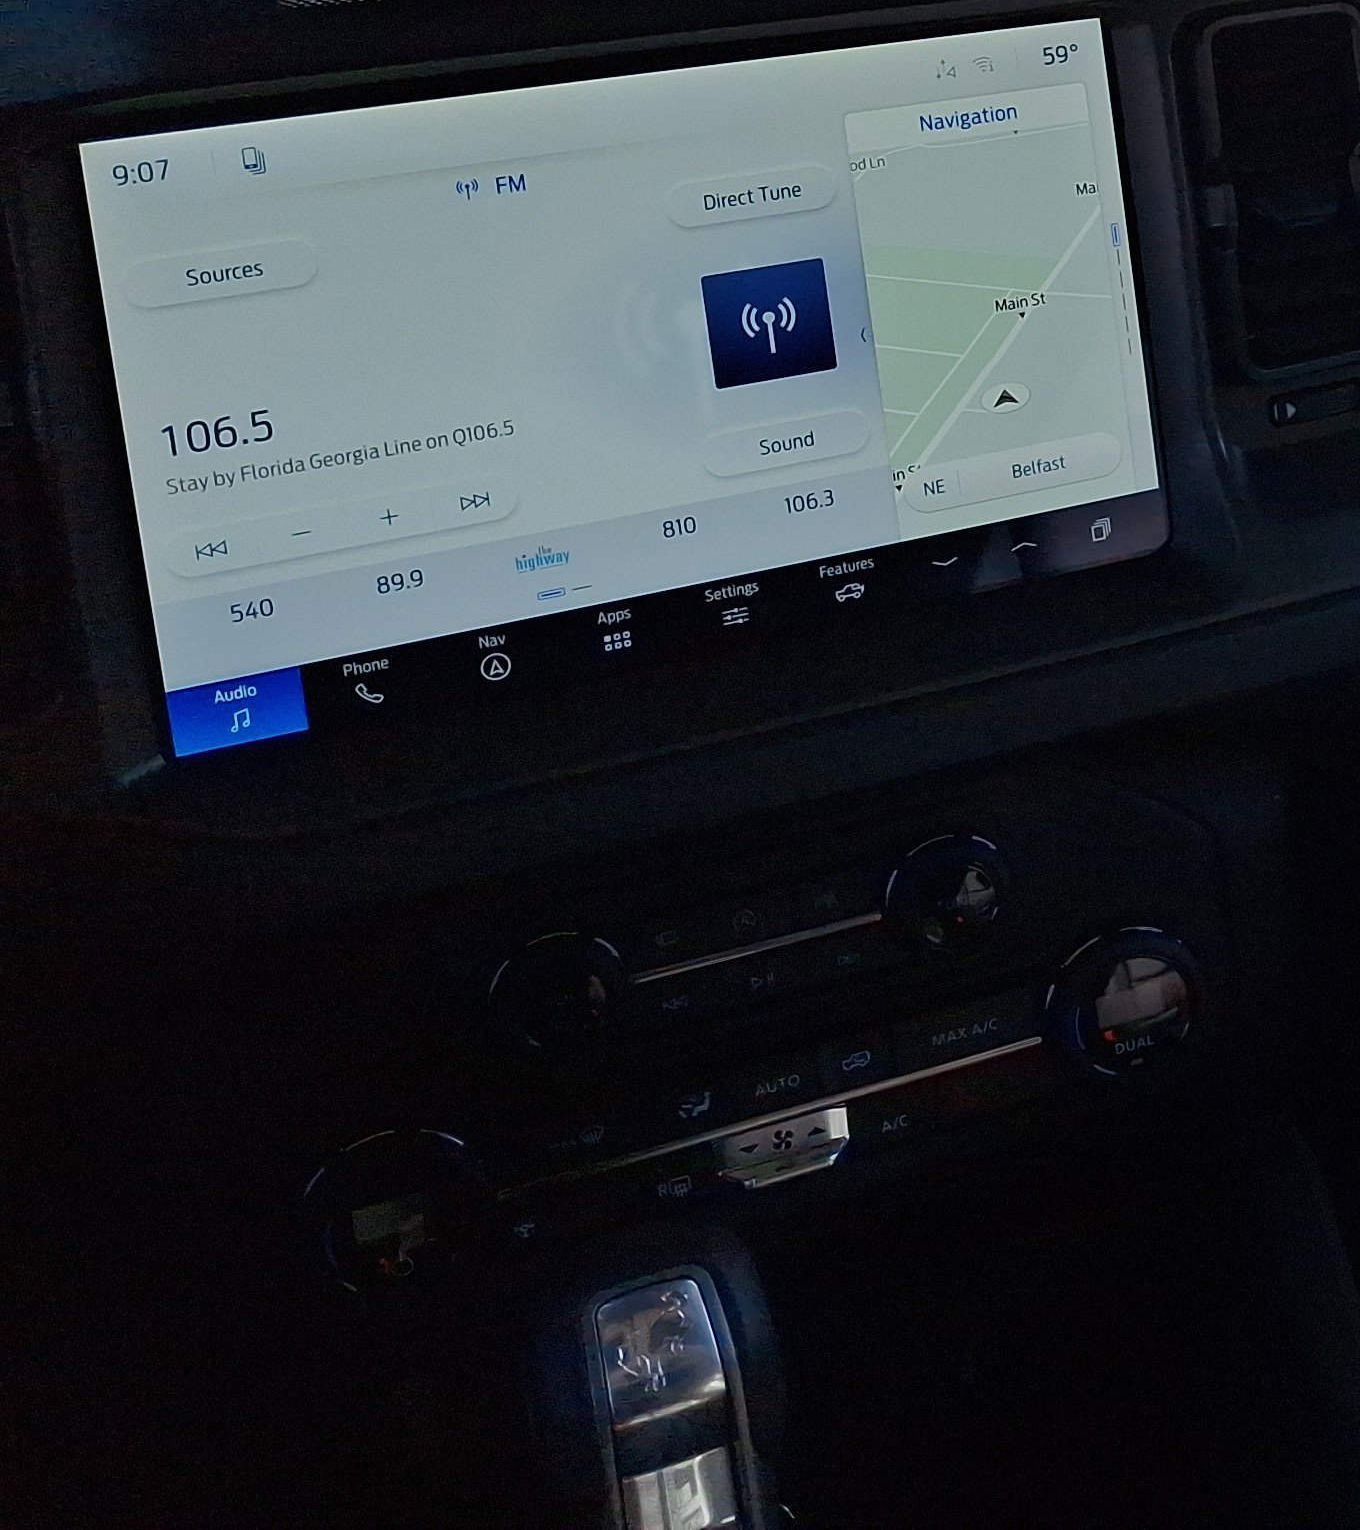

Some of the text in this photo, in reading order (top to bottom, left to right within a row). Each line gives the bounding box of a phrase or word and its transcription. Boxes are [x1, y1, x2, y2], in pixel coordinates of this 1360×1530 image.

[1041, 43, 1079, 66] 59°
[919, 103, 1018, 132] Navigation
[112, 159, 170, 186] 9:07
[869, 155, 886, 169] Ln
[495, 173, 527, 195] FM
[703, 181, 802, 212] Direct Tune
[186, 259, 265, 288] Sources
[994, 292, 1046, 313] Main St
[161, 408, 274, 457] 106.5
[758, 431, 815, 456] Sound
[166, 419, 515, 496] Stay by Florida Georgia Line on Q106.5
[1011, 455, 1066, 479] Belfast
[923, 478, 946, 497] NE
[229, 489, 835, 624] 540 89.9 810 106.3
[515, 548, 570, 573] highway
[214, 556, 875, 705] Audio Phone Nav Apps Settings Features
[932, 1018, 999, 1047] MAX A/C
[1113, 1035, 1155, 1056] DUAL
[754, 1074, 802, 1098] AUTO
[881, 1113, 910, 1133] A/C
